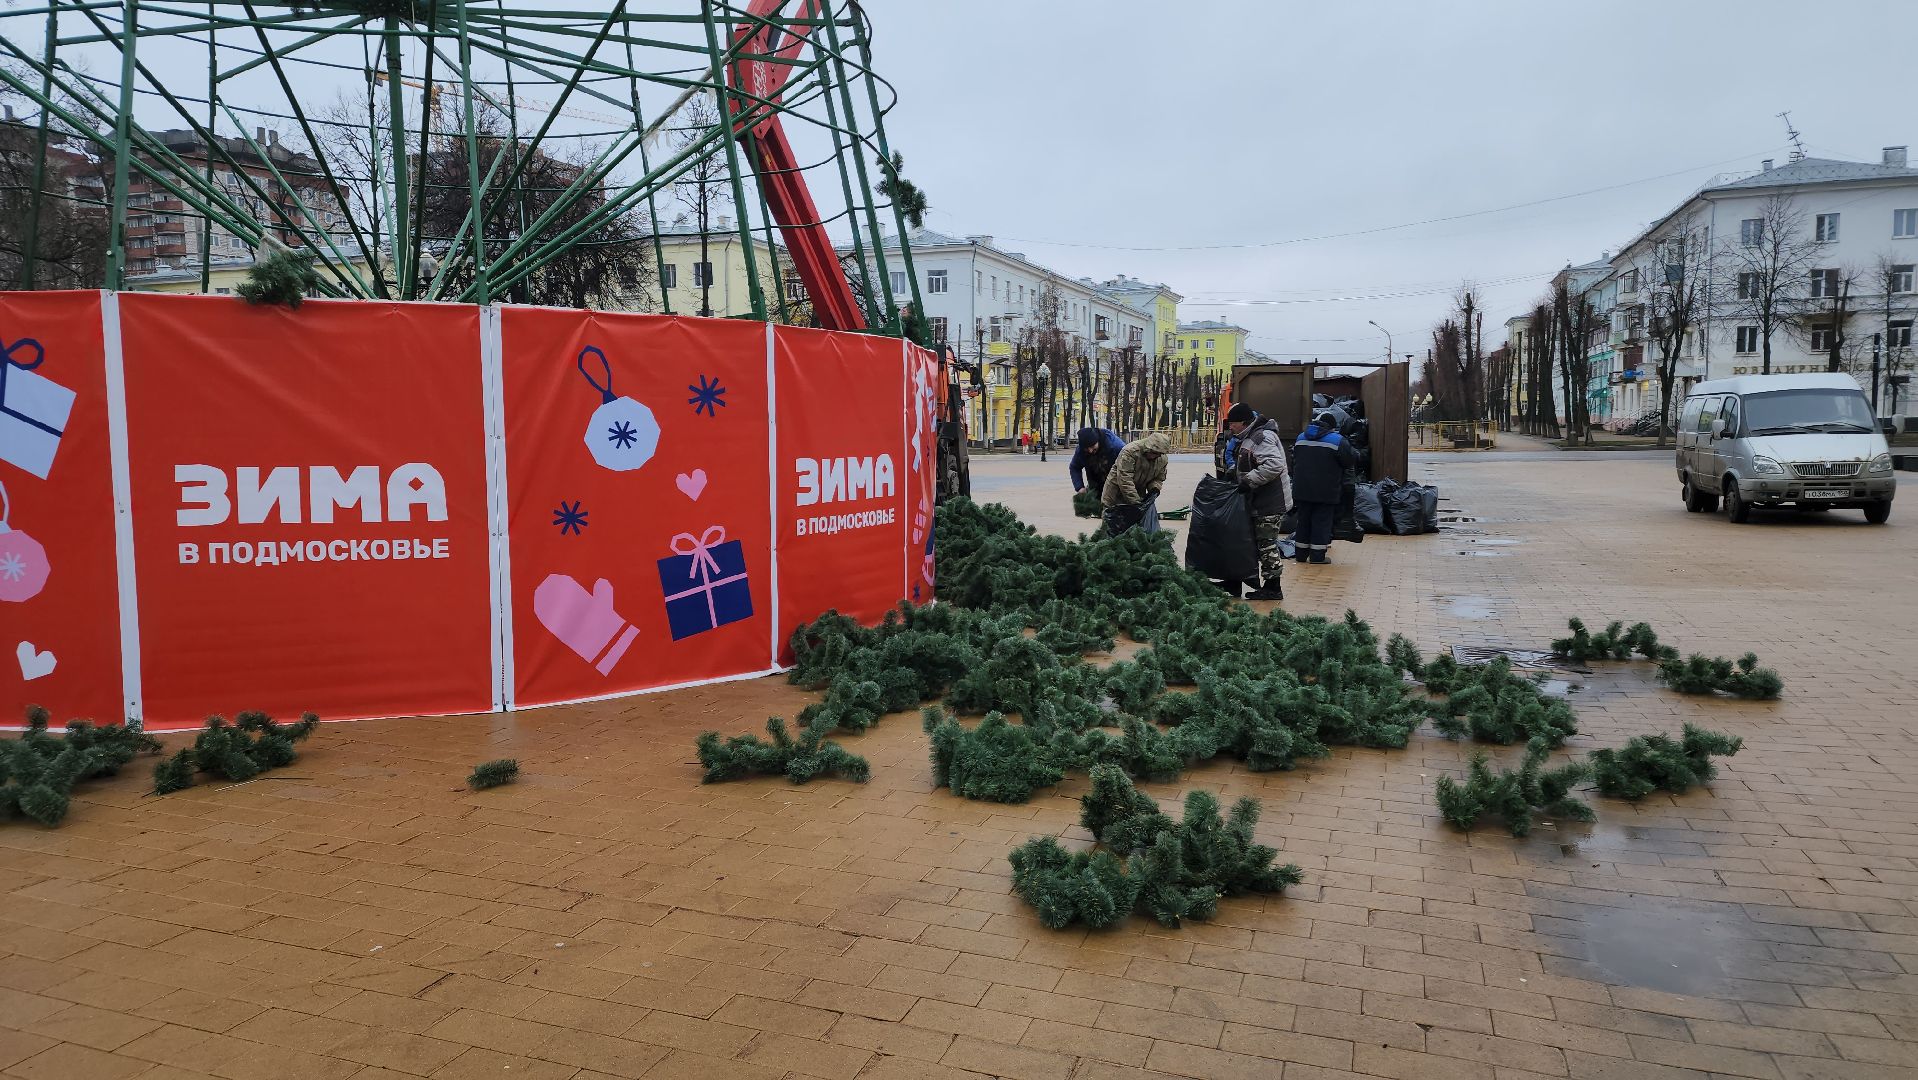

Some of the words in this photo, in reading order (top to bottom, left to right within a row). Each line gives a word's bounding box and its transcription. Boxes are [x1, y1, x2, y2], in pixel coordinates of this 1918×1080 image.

[174, 462, 449, 527] ЗИМА
[796, 453, 895, 507] ЗИМА
[796, 519, 807, 537] В
[808, 507, 895, 536] ПОДМОСКОВЬЕ
[178, 542, 200, 564] В
[208, 538, 450, 567] ПОДМОСКОВЬЕ
